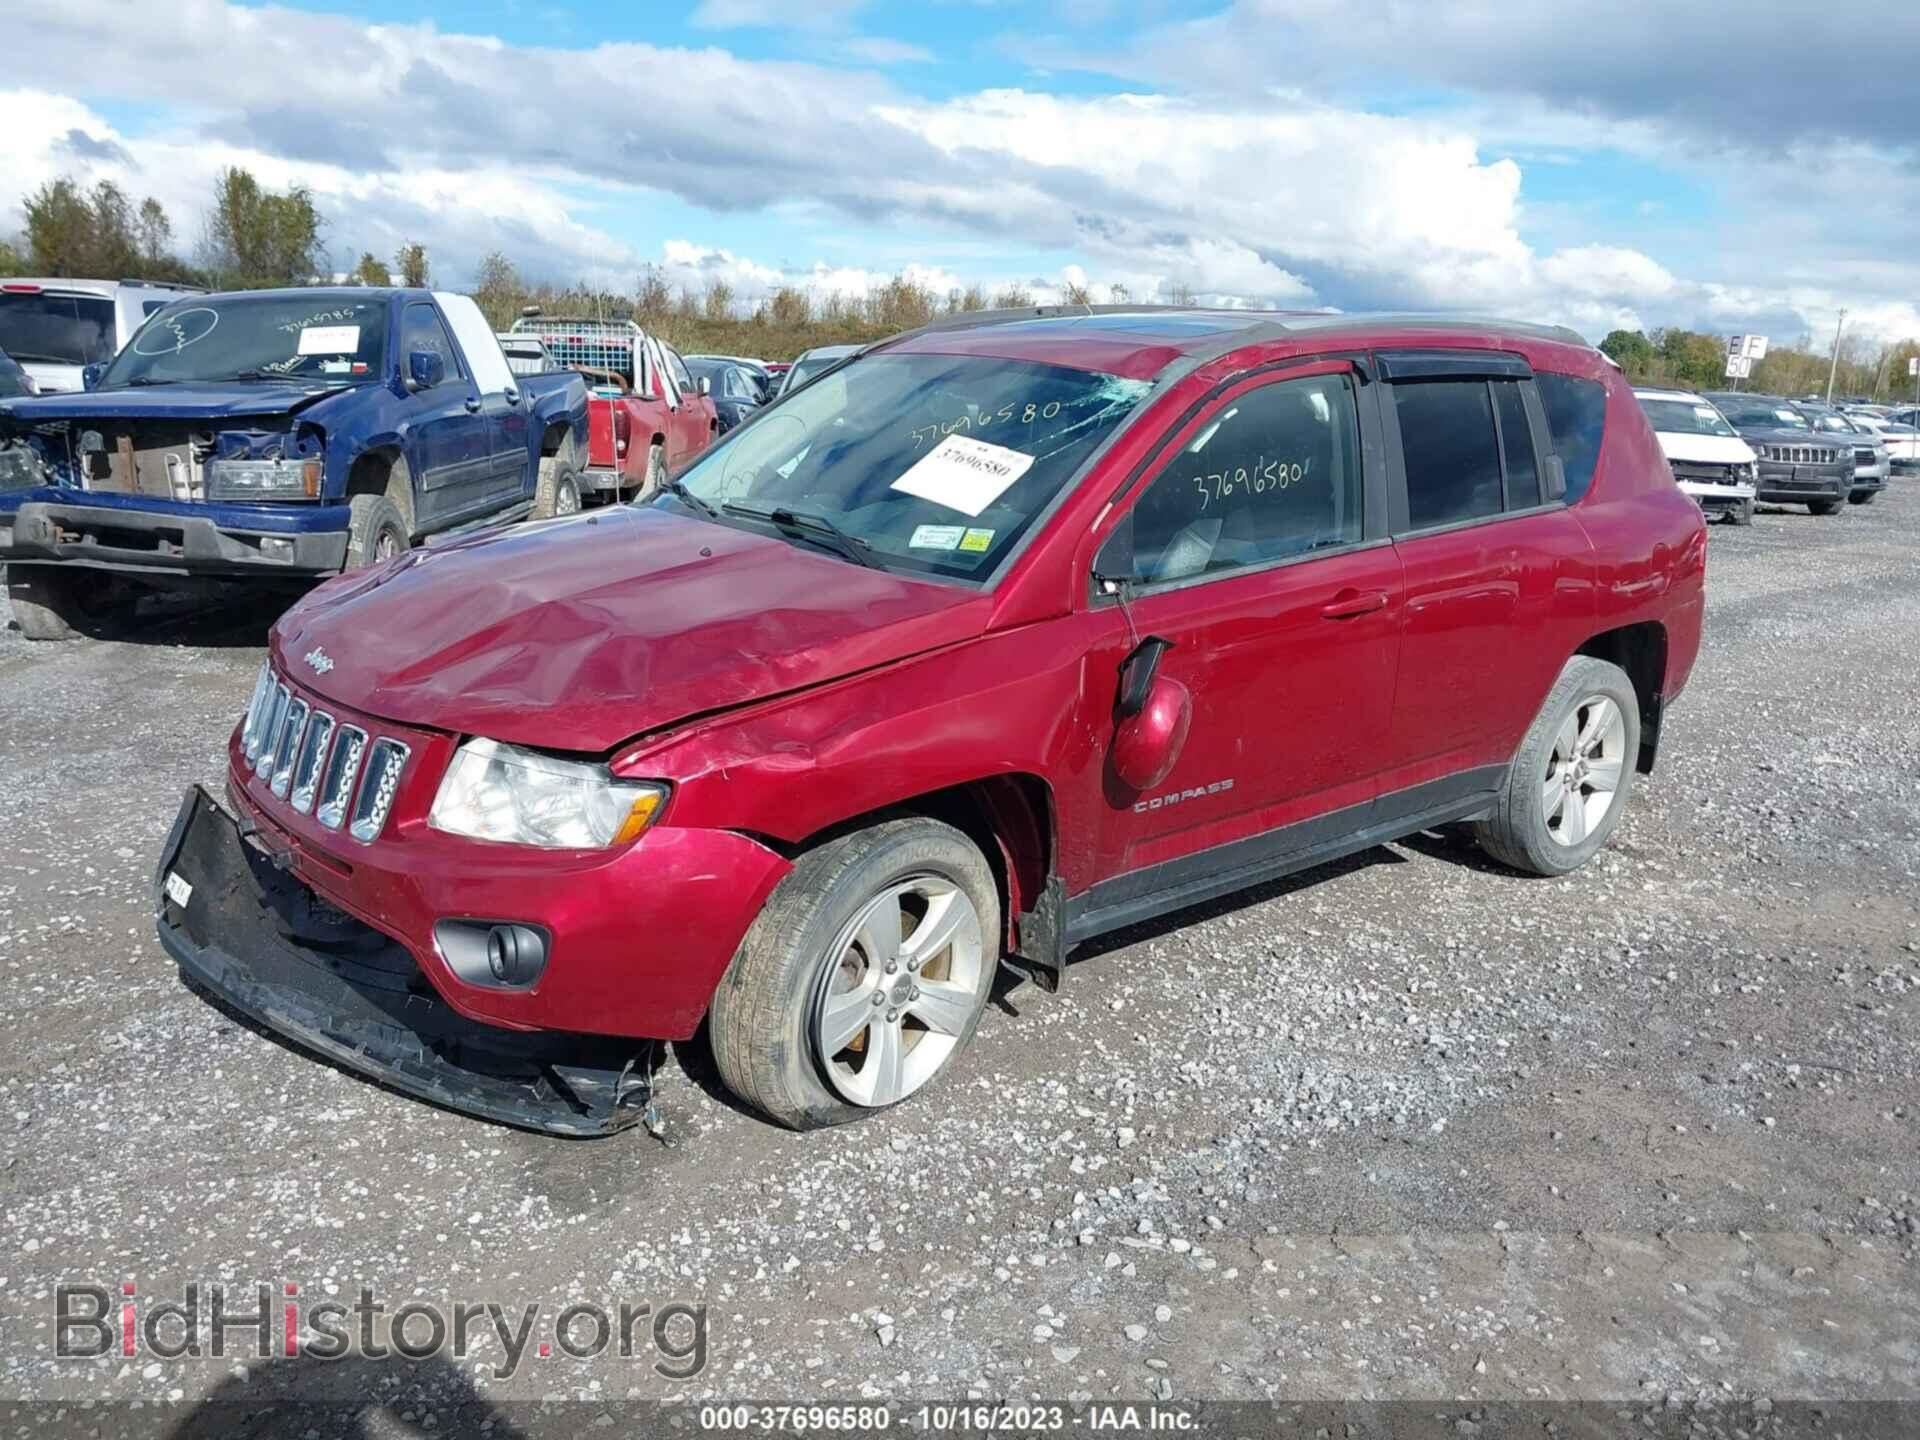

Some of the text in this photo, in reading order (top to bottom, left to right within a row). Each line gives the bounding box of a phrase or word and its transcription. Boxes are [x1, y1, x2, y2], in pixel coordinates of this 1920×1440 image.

[1729, 336, 1741, 355] E
[1747, 336, 1762, 356] F
[1728, 356, 1750, 376] 50
[911, 401, 1061, 449] 37696580
[936, 448, 1011, 477] 37696580
[1133, 778, 1234, 813] COMPASS
